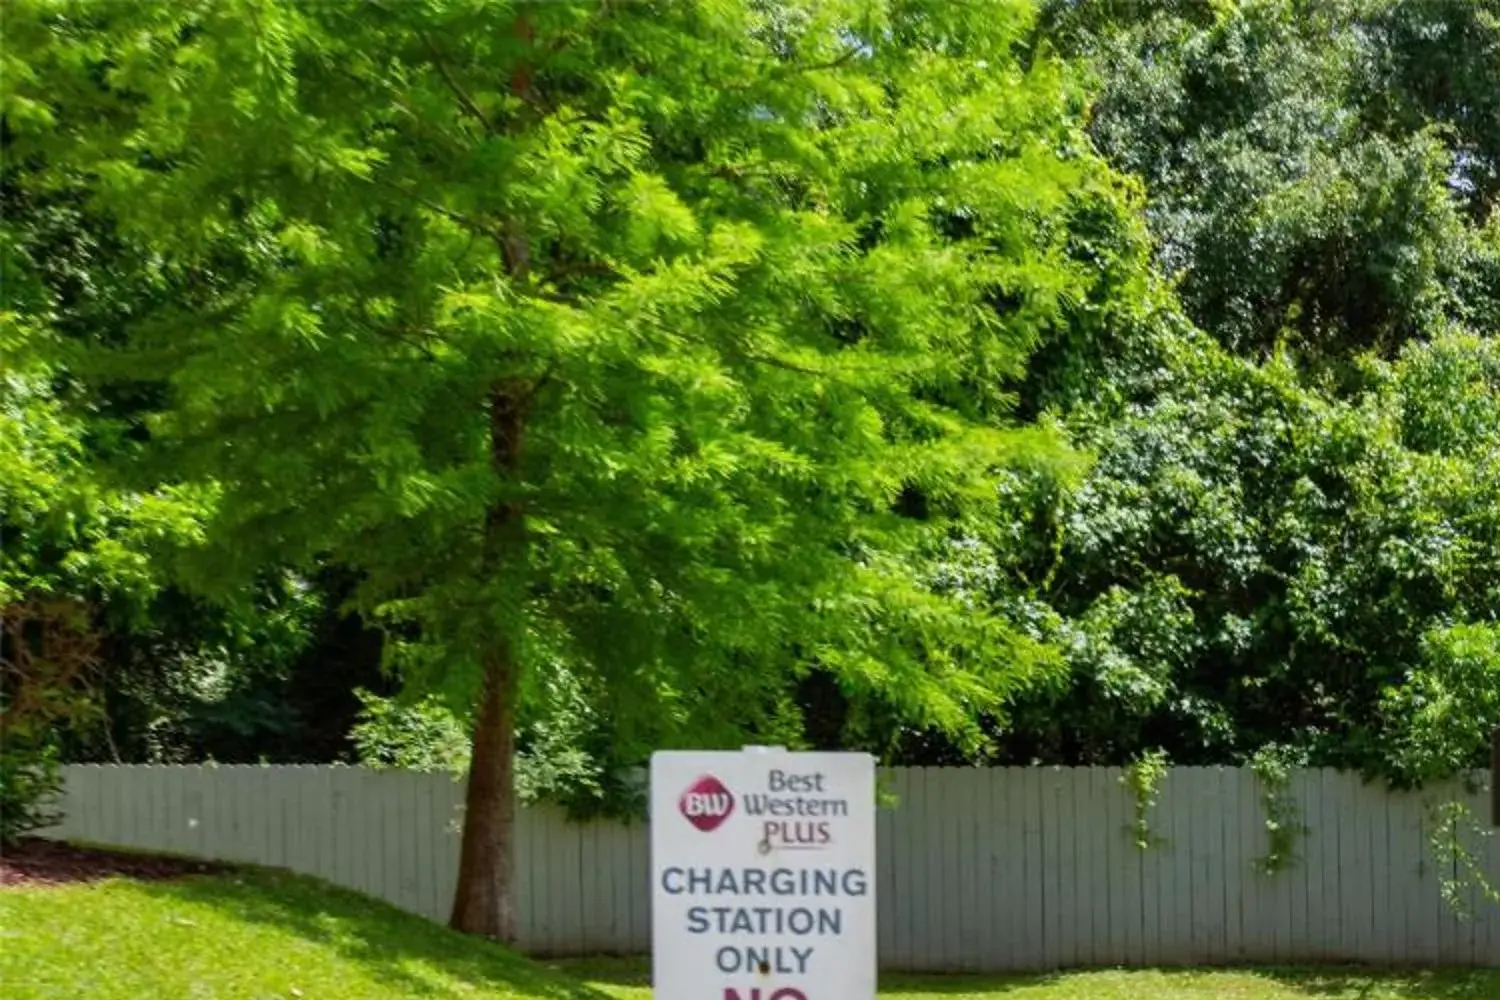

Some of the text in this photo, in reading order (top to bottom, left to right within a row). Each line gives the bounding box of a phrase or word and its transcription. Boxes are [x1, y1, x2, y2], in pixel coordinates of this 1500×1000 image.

[768, 769, 824, 792] Best
[686, 793, 729, 817] BW
[743, 794, 848, 816] Western
[764, 821, 831, 844] PLUS
[661, 867, 867, 896] CHARGING
[687, 907, 841, 935] STATION
[716, 946, 814, 973] ONLY
